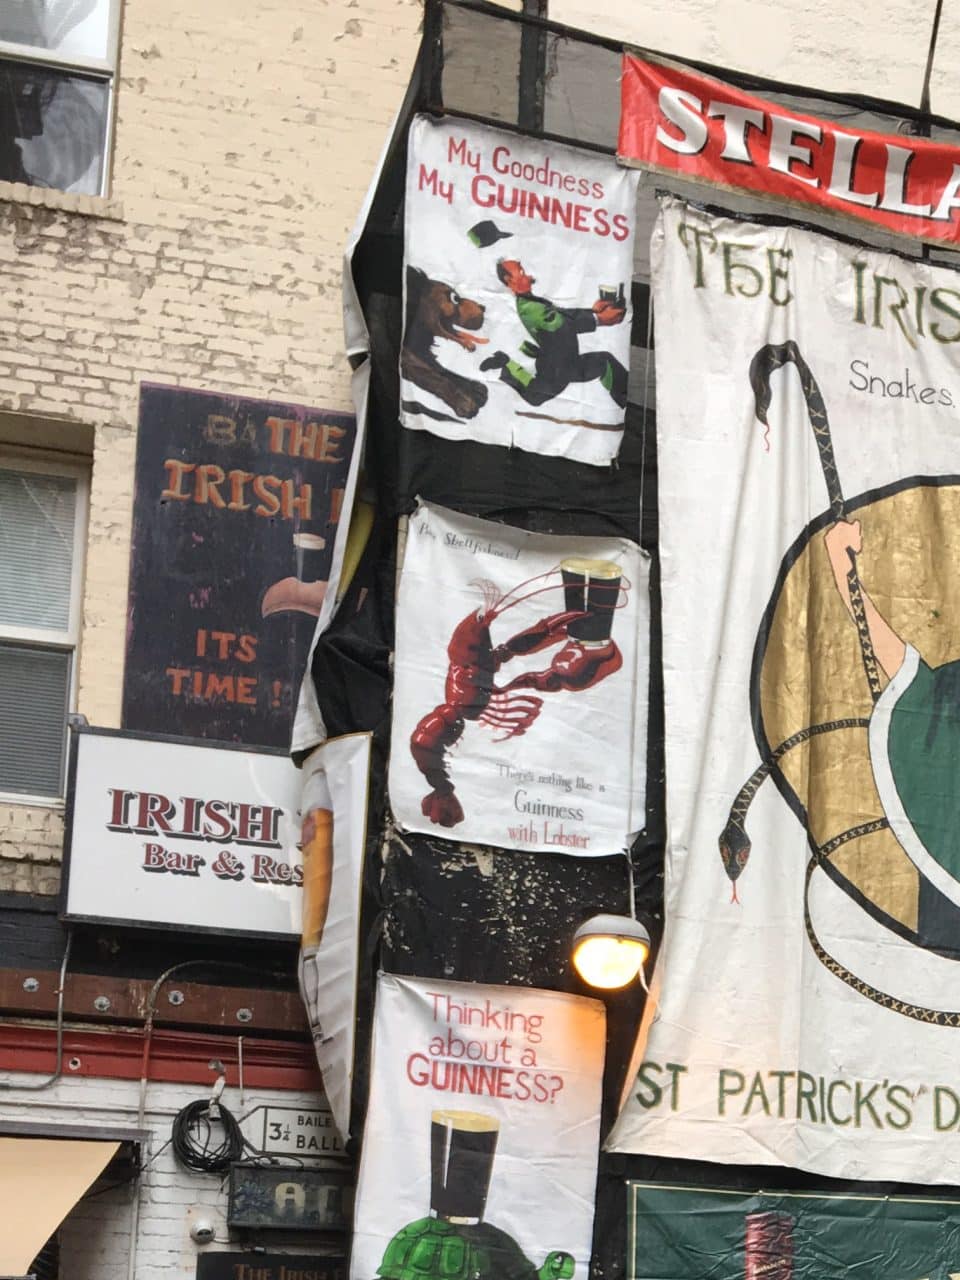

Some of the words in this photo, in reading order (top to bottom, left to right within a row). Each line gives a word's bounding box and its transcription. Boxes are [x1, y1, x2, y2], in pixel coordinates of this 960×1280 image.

[448, 136, 481, 174] My
[492, 147, 604, 200] Goodness
[418, 163, 454, 205] My
[471, 174, 630, 242] GUINNESS
[678, 222, 794, 306] THE
[265, 416, 347, 463] THE
[162, 459, 312, 520] IRISH
[196, 629, 257, 662] ITS
[166, 667, 257, 704] TIME
[107, 788, 283, 848] IRISH
[514, 789, 584, 821] Guinness
[508, 820, 538, 844] with
[544, 821, 590, 848] Lobster
[143, 843, 205, 876] Bar
[211, 850, 245, 881] &
[426, 992, 544, 1043] Thinking
[429, 1028, 512, 1067] about
[521, 1048, 537, 1068] a
[407, 1053, 563, 1105] GUINNESS?
[635, 1062, 687, 1109] ST
[718, 1069, 912, 1129] PATRICK'S
